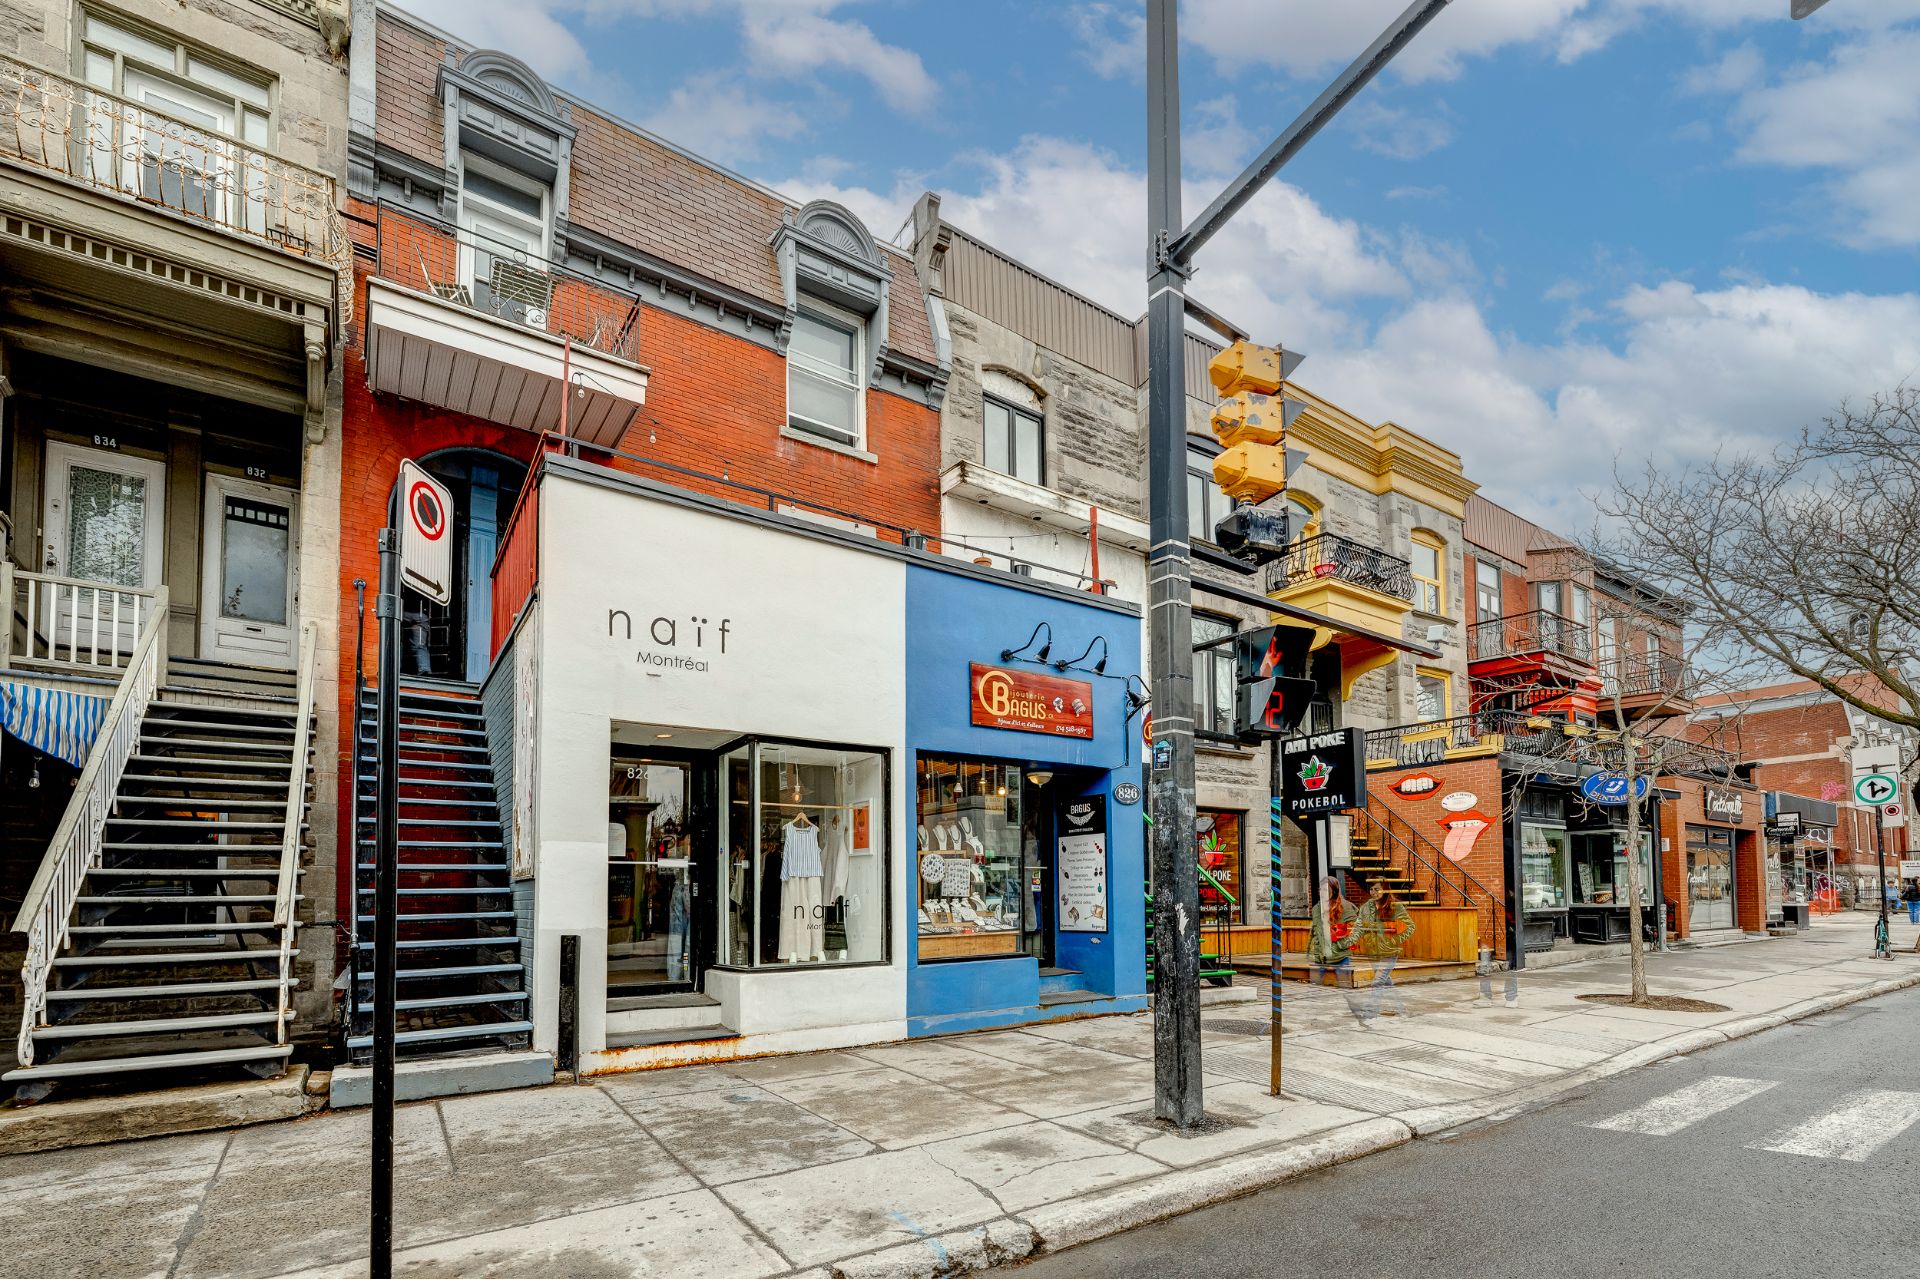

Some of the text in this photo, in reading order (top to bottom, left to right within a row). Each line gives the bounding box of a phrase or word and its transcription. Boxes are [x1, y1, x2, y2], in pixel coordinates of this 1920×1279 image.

[94, 435, 117, 448] 834
[247, 466, 266, 479] 832
[609, 608, 731, 654] naïf
[636, 651, 709, 673] Montréal
[1309, 731, 1346, 750] POKE
[1118, 787, 1138, 799] 826
[1070, 803, 1092, 815] BAGUS
[1292, 794, 1346, 811] POKEBOL
